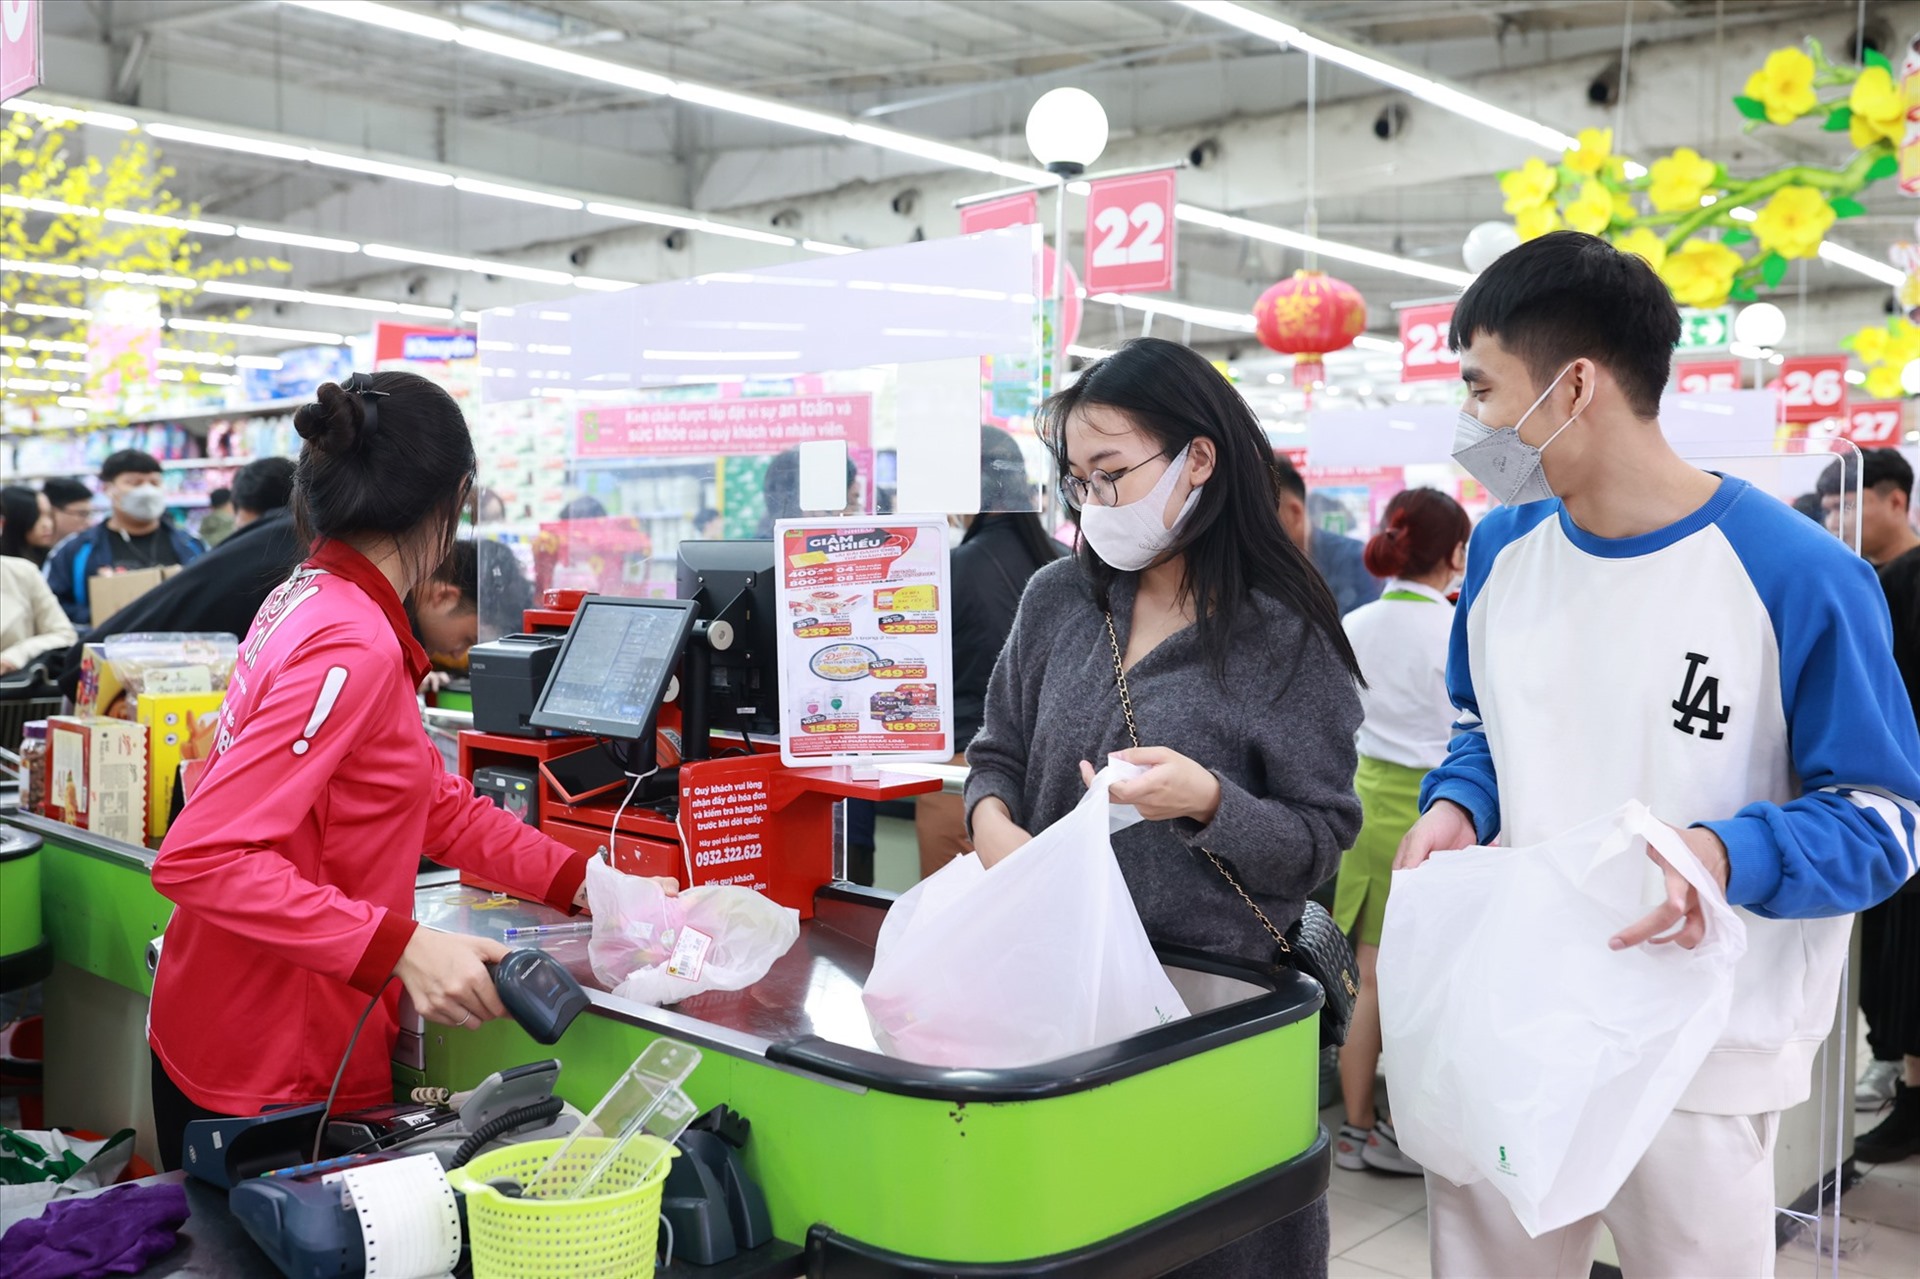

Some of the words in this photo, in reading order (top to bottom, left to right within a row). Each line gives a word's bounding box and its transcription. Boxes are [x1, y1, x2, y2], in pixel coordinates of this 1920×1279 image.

[1092, 202, 1165, 268] 22
[1784, 370, 1841, 407] 26
[778, 404, 797, 418] an
[1851, 411, 1899, 441] 27
[809, 534, 853, 548] GIẢM
[1672, 652, 1730, 740] LA
[711, 784, 733, 794] khách
[734, 782, 746, 791] vui
[747, 781, 763, 790] lòng
[692, 798, 711, 809] nhận
[738, 794, 752, 803] hóa
[752, 792, 767, 800] đơn
[693, 810, 703, 819] và
[723, 808, 734, 816] tra
[735, 805, 753, 815] hàng
[697, 821, 717, 831] trước
[718, 819, 730, 828] khi
[695, 844, 762, 867] 0932.322.622
[734, 874, 755, 883] khách
